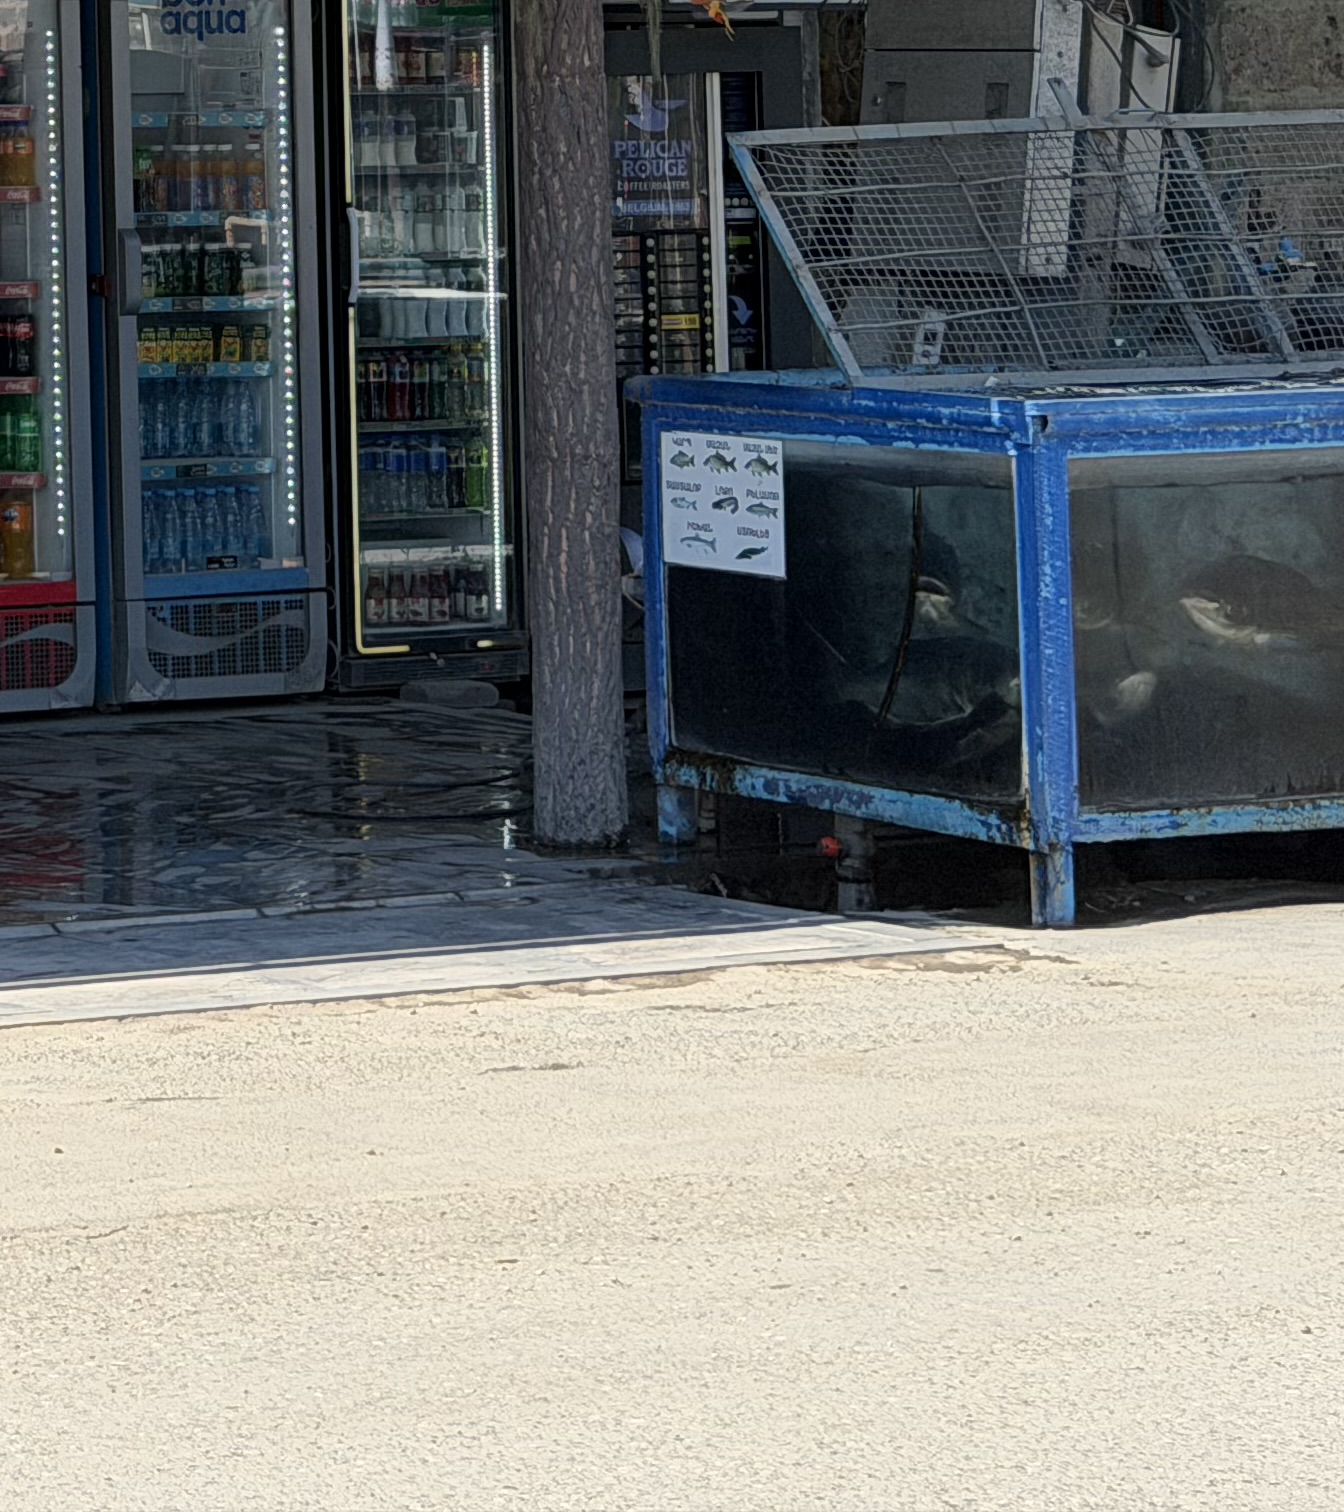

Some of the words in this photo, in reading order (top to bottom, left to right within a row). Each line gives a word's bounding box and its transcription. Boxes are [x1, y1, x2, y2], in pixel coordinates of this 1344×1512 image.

[160, 8, 248, 42] aqua
[614, 139, 691, 159] PELICAN
[621, 158, 688, 178] ROUGE
